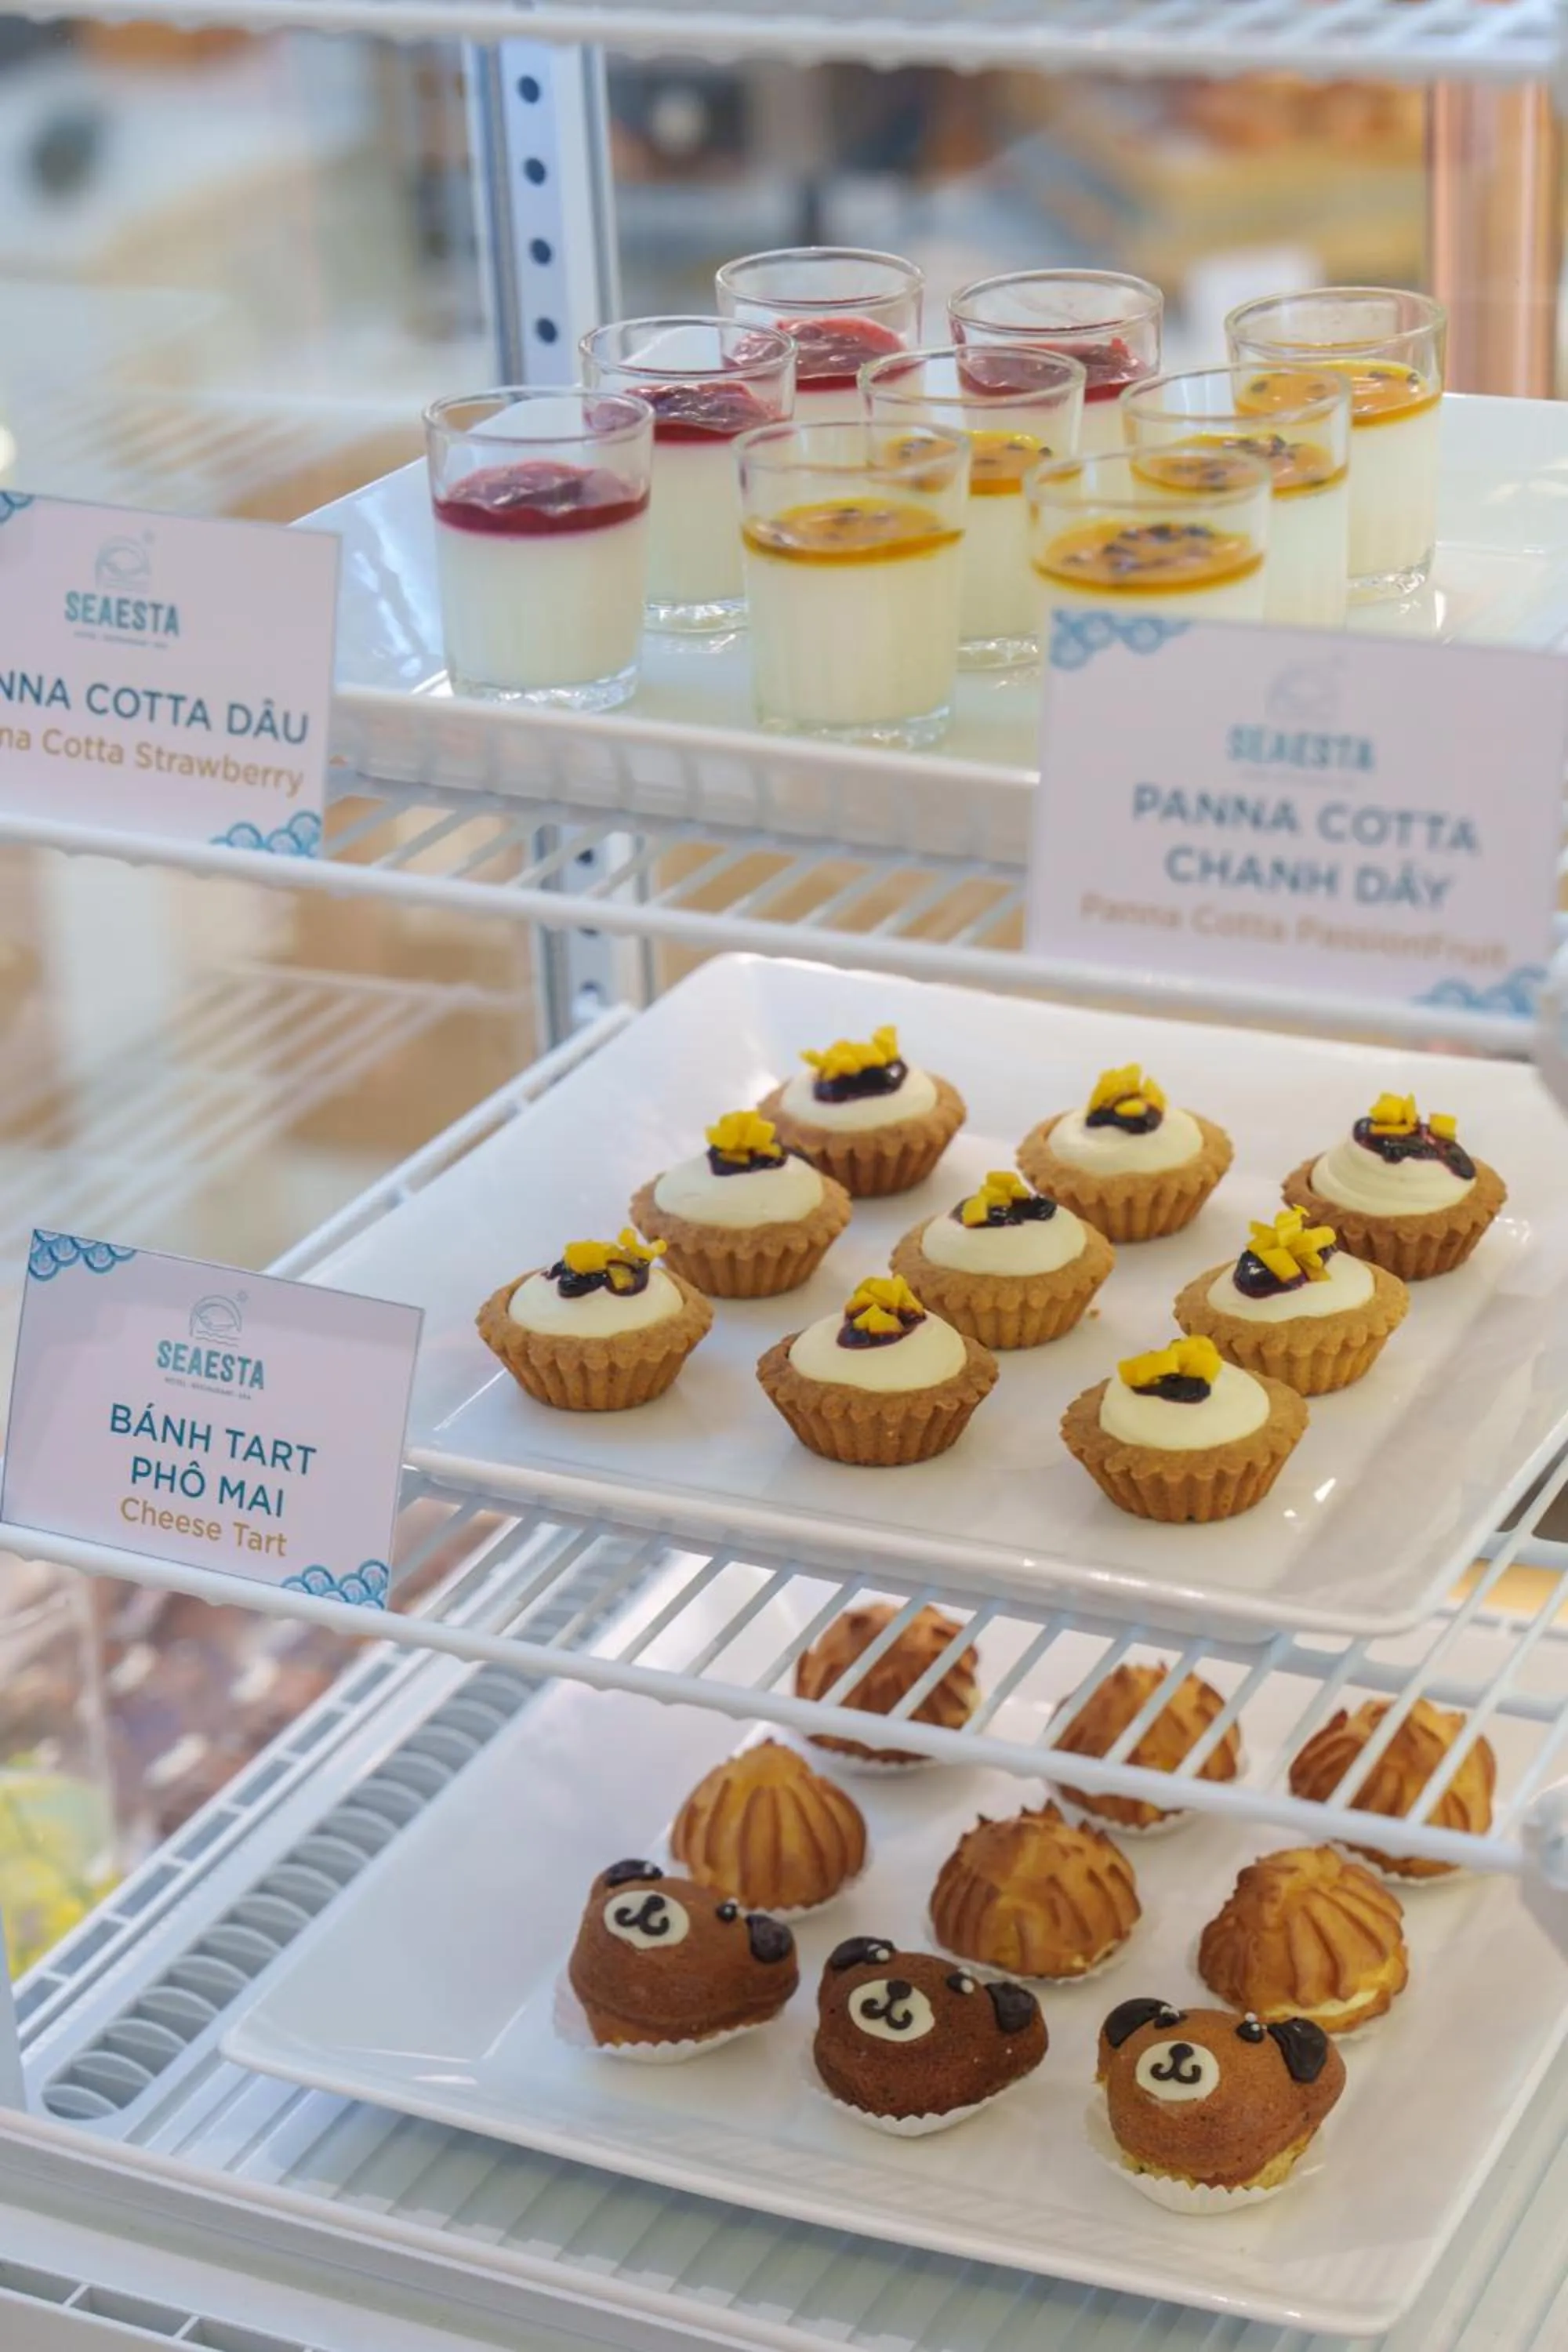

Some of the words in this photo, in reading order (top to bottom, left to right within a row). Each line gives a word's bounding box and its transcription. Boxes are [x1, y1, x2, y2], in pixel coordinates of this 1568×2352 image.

[64, 590, 180, 637] SEAESTA
[85, 683, 212, 731] COTTA
[227, 699, 308, 745] DÂU
[42, 728, 124, 765] Cotta
[135, 742, 303, 798] Strawberry
[1227, 724, 1375, 771] SEAESTA
[1132, 783, 1300, 835] PANNA
[1317, 803, 1480, 857] COTTA
[1165, 845, 1338, 898] CHANH
[157, 1340, 264, 1390] SEAESTA
[110, 1403, 212, 1452] BÁNH
[225, 1428, 317, 1475] TART
[131, 1456, 205, 1498] PHÔ
[219, 1475, 284, 1518] MAI
[120, 1497, 223, 1541] Cheese
[233, 1520, 287, 1557] Tart
